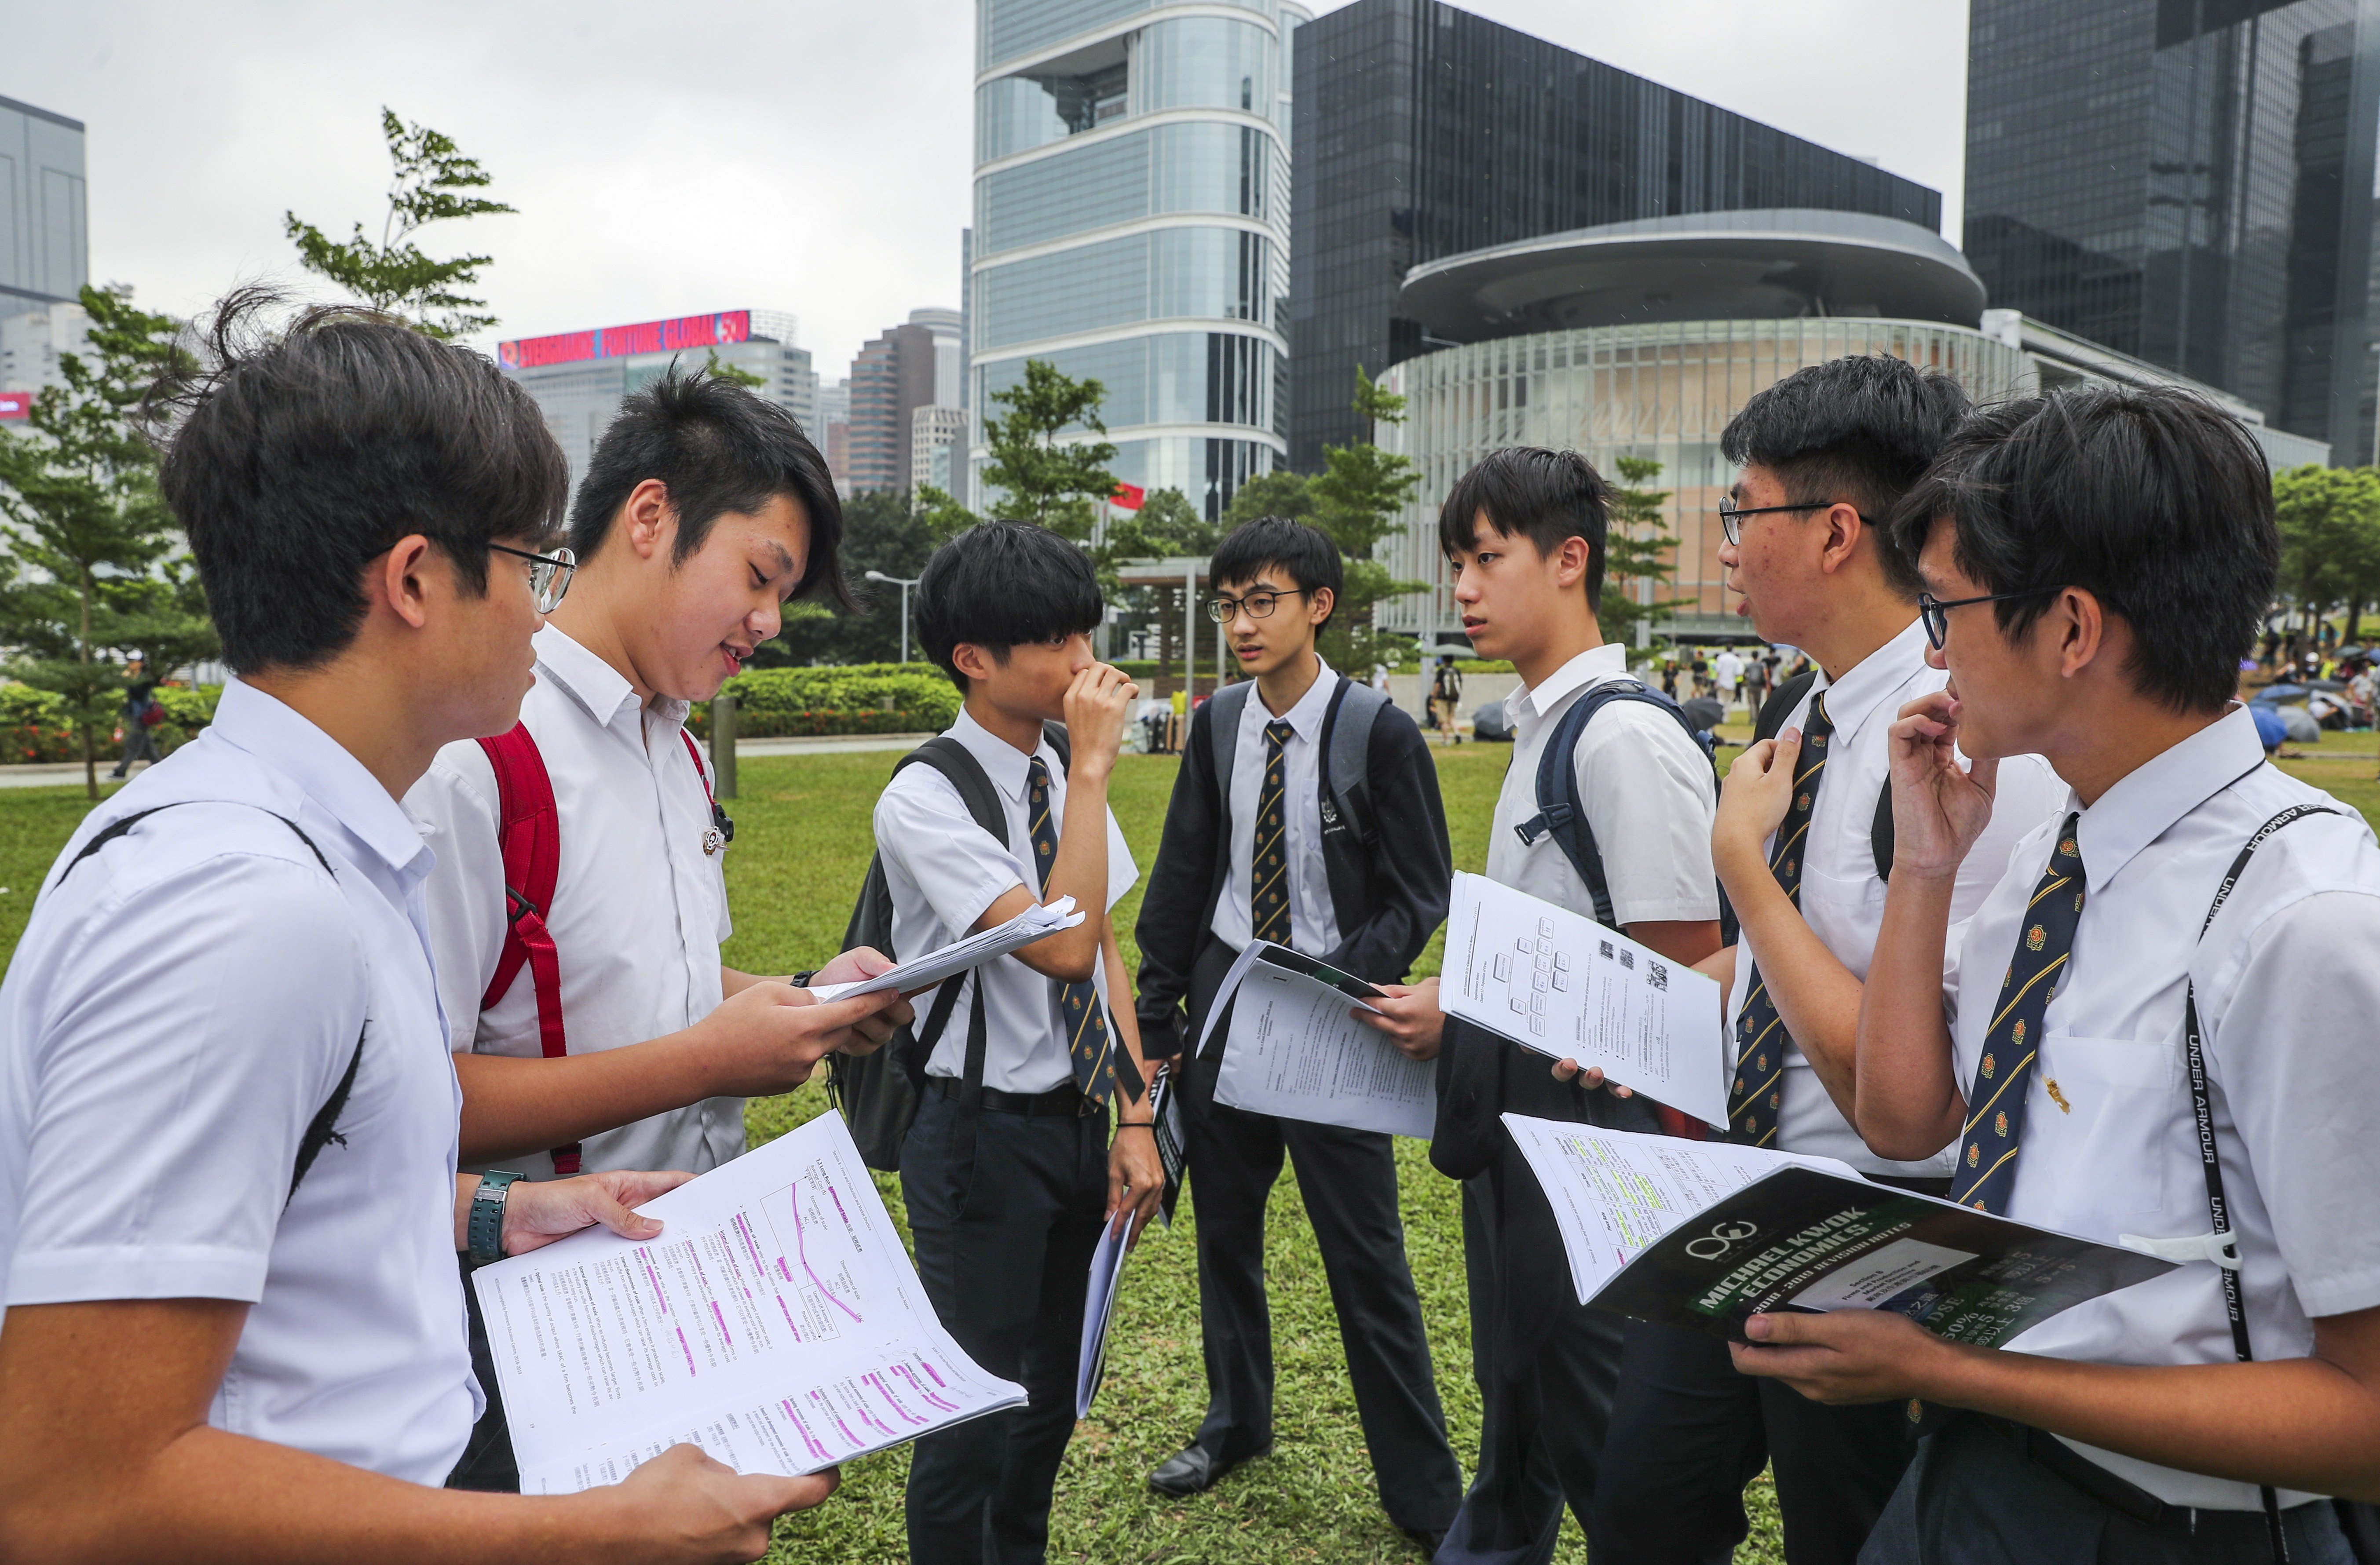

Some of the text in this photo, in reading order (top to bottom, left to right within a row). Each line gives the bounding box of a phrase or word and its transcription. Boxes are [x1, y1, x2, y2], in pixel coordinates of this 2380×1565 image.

[664, 314, 718, 350] GLOBAL
[721, 310, 748, 342] 500
[2246, 808, 2297, 851] ARMOUR
[2189, 1034, 2215, 1164] UNDER ARMOUR
[808, 1164, 820, 1181] Average
[831, 1150, 841, 1162] Section
[846, 1182, 858, 1199] Production
[857, 1205, 866, 1217] Market
[862, 1216, 873, 1231] Structure
[809, 1195, 823, 1216] Economies
[820, 1220, 829, 1231] scale
[818, 1165, 827, 1176] Long
[828, 1186, 842, 1207] Economies
[840, 1212, 849, 1224] Scale
[2211, 1197, 2226, 1235] UNDE
[739, 1226, 751, 1246] production
[748, 1245, 757, 1260] quantity
[742, 1211, 754, 1233] Economies
[766, 1271, 776, 1287] situation
[775, 1294, 786, 1309] average
[1697, 1246, 1794, 1308] MICHAEL
[1785, 1206, 1868, 1246] KWOK
[1739, 1223, 1870, 1297] ECONOMICS
[777, 1257, 792, 1282] Optimal Scale
[839, 1260, 855, 1286] Diseconomies
[853, 1290, 861, 1300] scale
[1752, 1292, 1783, 1313] 2018
[1783, 1270, 1816, 1289] 2019
[1813, 1241, 1871, 1270] REVISION
[1866, 1222, 1913, 1243] NOTES
[1841, 1289, 1861, 1300] Firms
[1870, 1266, 1908, 1283] Production
[1848, 1273, 1878, 1287] Section
[1861, 1269, 1916, 1294] Market Structure
[812, 1290, 822, 1304] Lowest
[819, 1309, 830, 1323] Average
[826, 1322, 834, 1332] Cost
[902, 1299, 910, 1310] Notes
[1927, 1297, 1967, 1322] DSE
[800, 1310, 818, 1341] Production (units)
[513, 1355, 522, 1375] 2018-2019
[543, 1301, 552, 1317] quantity
[548, 1322, 557, 1336] output
[565, 1383, 575, 1405] becomes
